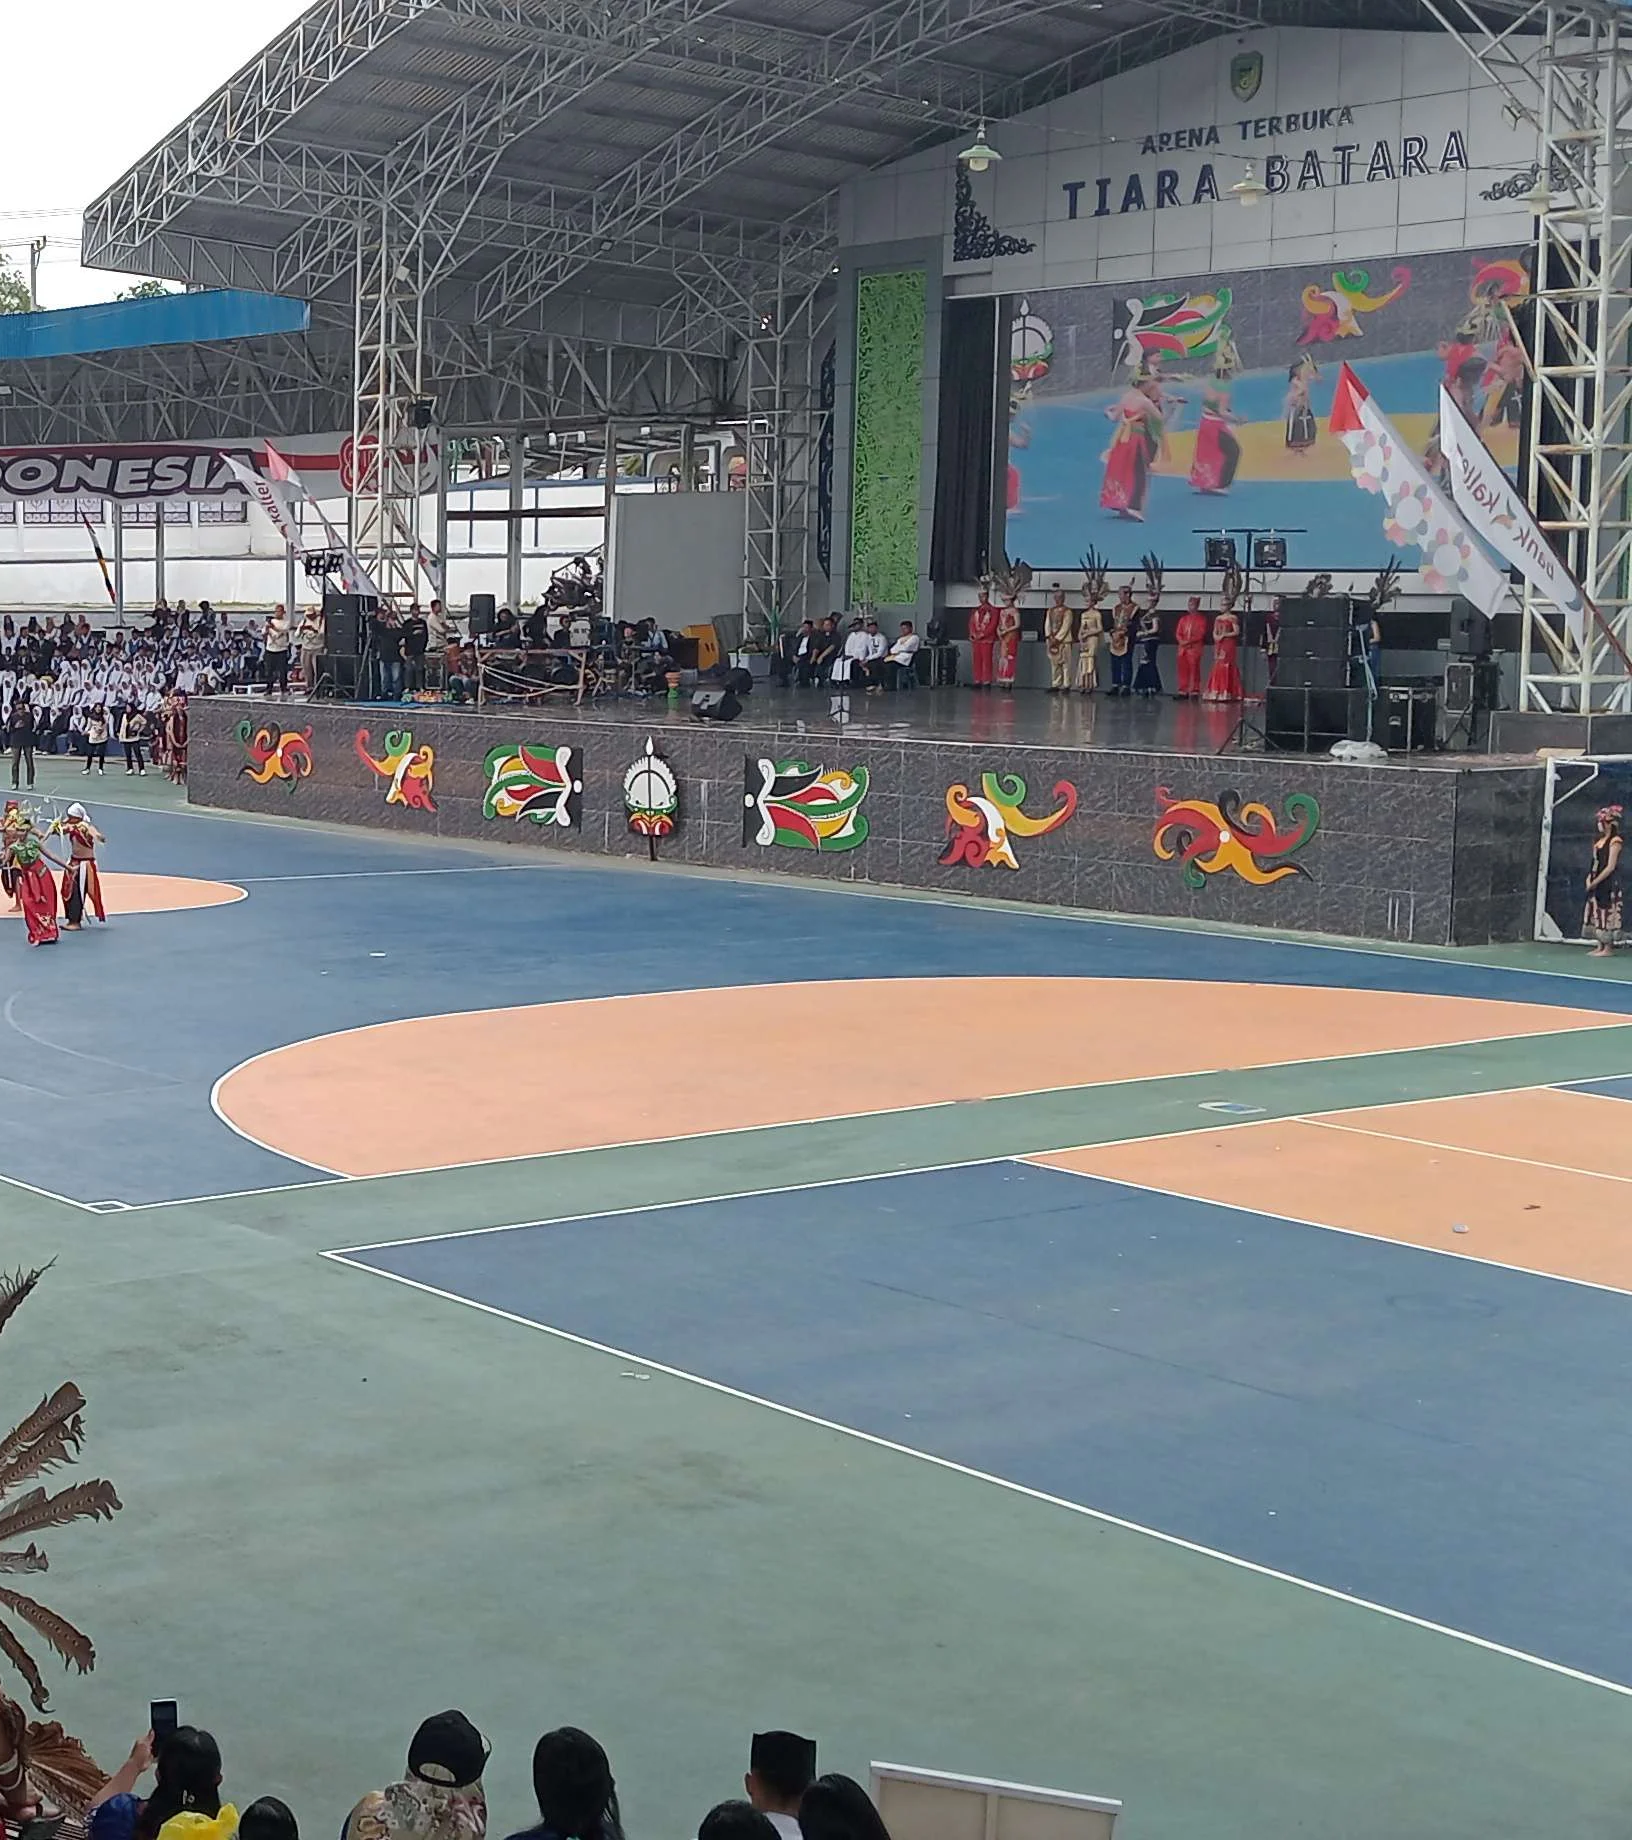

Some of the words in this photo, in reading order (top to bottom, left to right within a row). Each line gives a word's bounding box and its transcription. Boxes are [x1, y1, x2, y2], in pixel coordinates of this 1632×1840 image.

[1140, 124, 1220, 156] ARENA
[1237, 104, 1354, 141] TERBUKA
[1062, 163, 1222, 220] TIARA
[1264, 129, 1469, 195] BATARA
